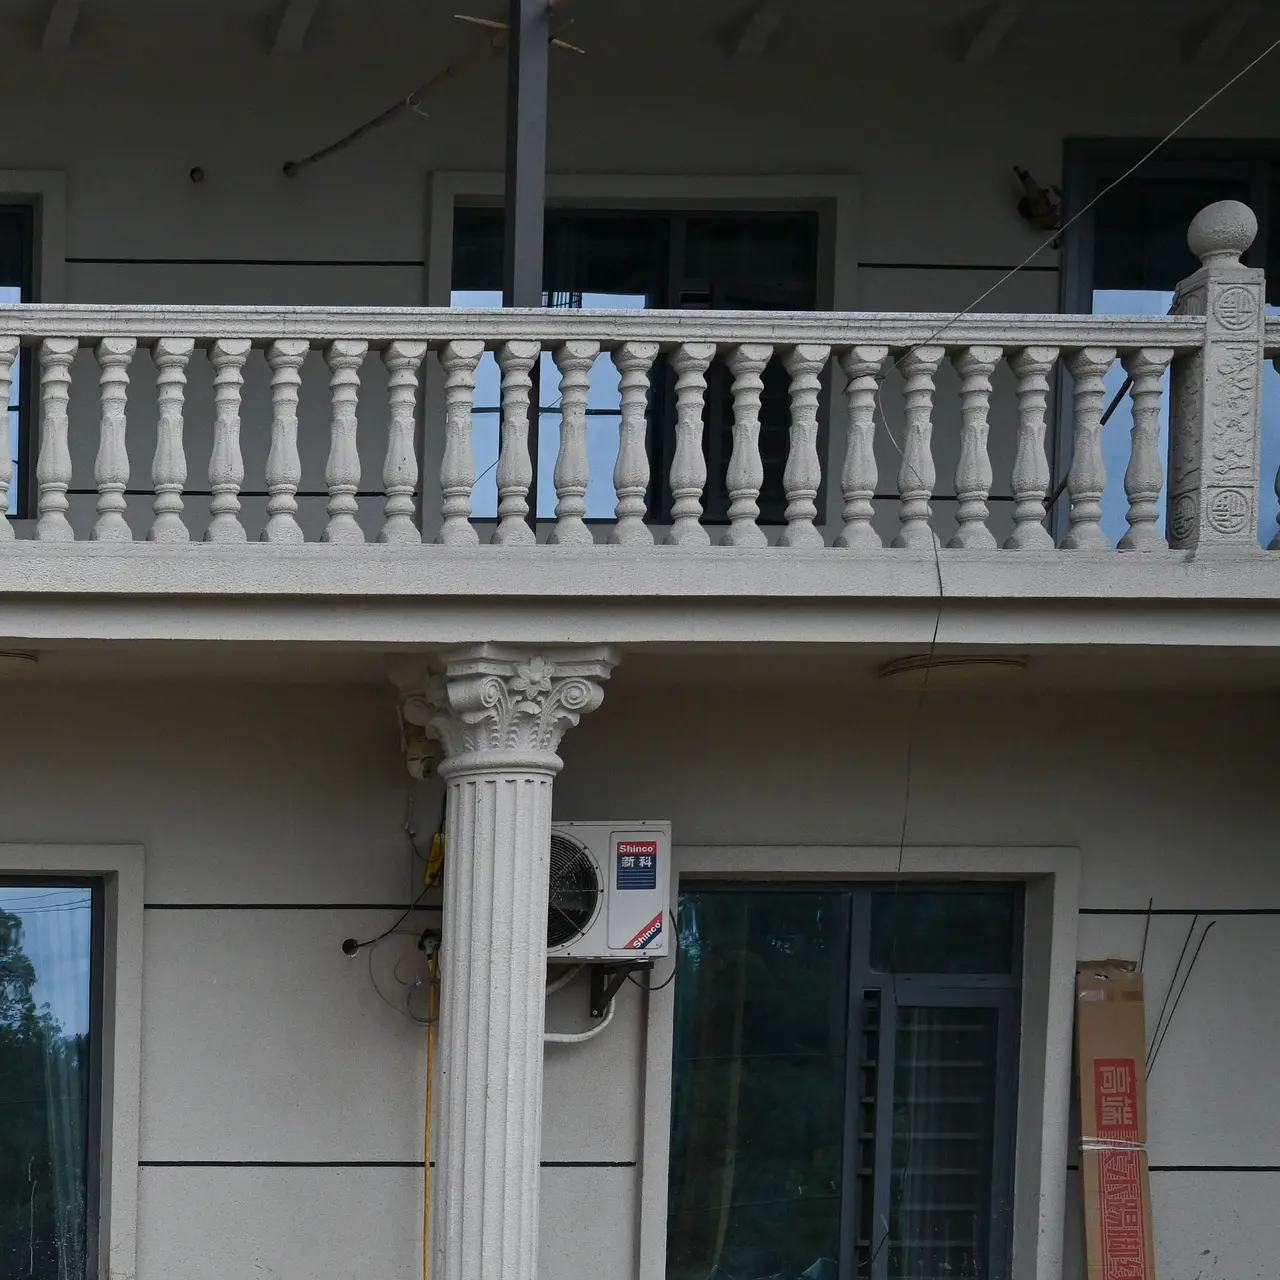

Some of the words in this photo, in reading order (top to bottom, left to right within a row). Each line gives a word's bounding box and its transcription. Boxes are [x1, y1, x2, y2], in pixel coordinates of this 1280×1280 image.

[619, 845, 654, 853] Shinco
[621, 856, 652, 868] 新科
[633, 921, 661, 949] Shinco
[1099, 1065, 1133, 1125] 高端
